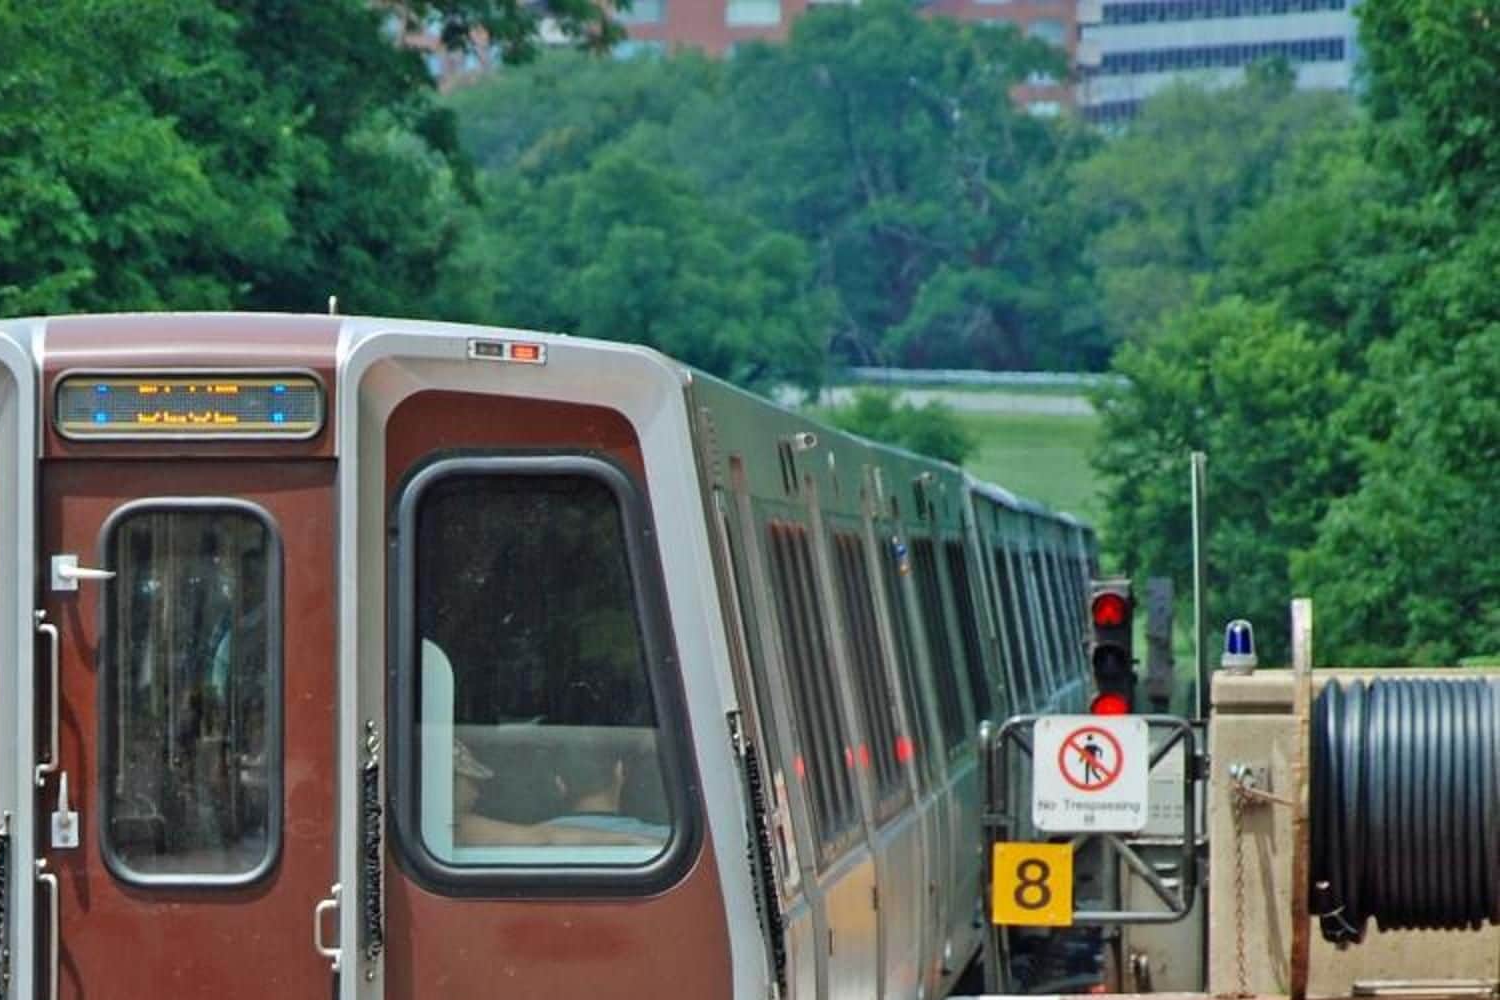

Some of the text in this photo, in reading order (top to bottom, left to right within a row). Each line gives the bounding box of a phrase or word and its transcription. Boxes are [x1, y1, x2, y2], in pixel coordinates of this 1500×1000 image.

[1037, 799, 1141, 813] No Trespassing
[1014, 858, 1051, 910] 8
